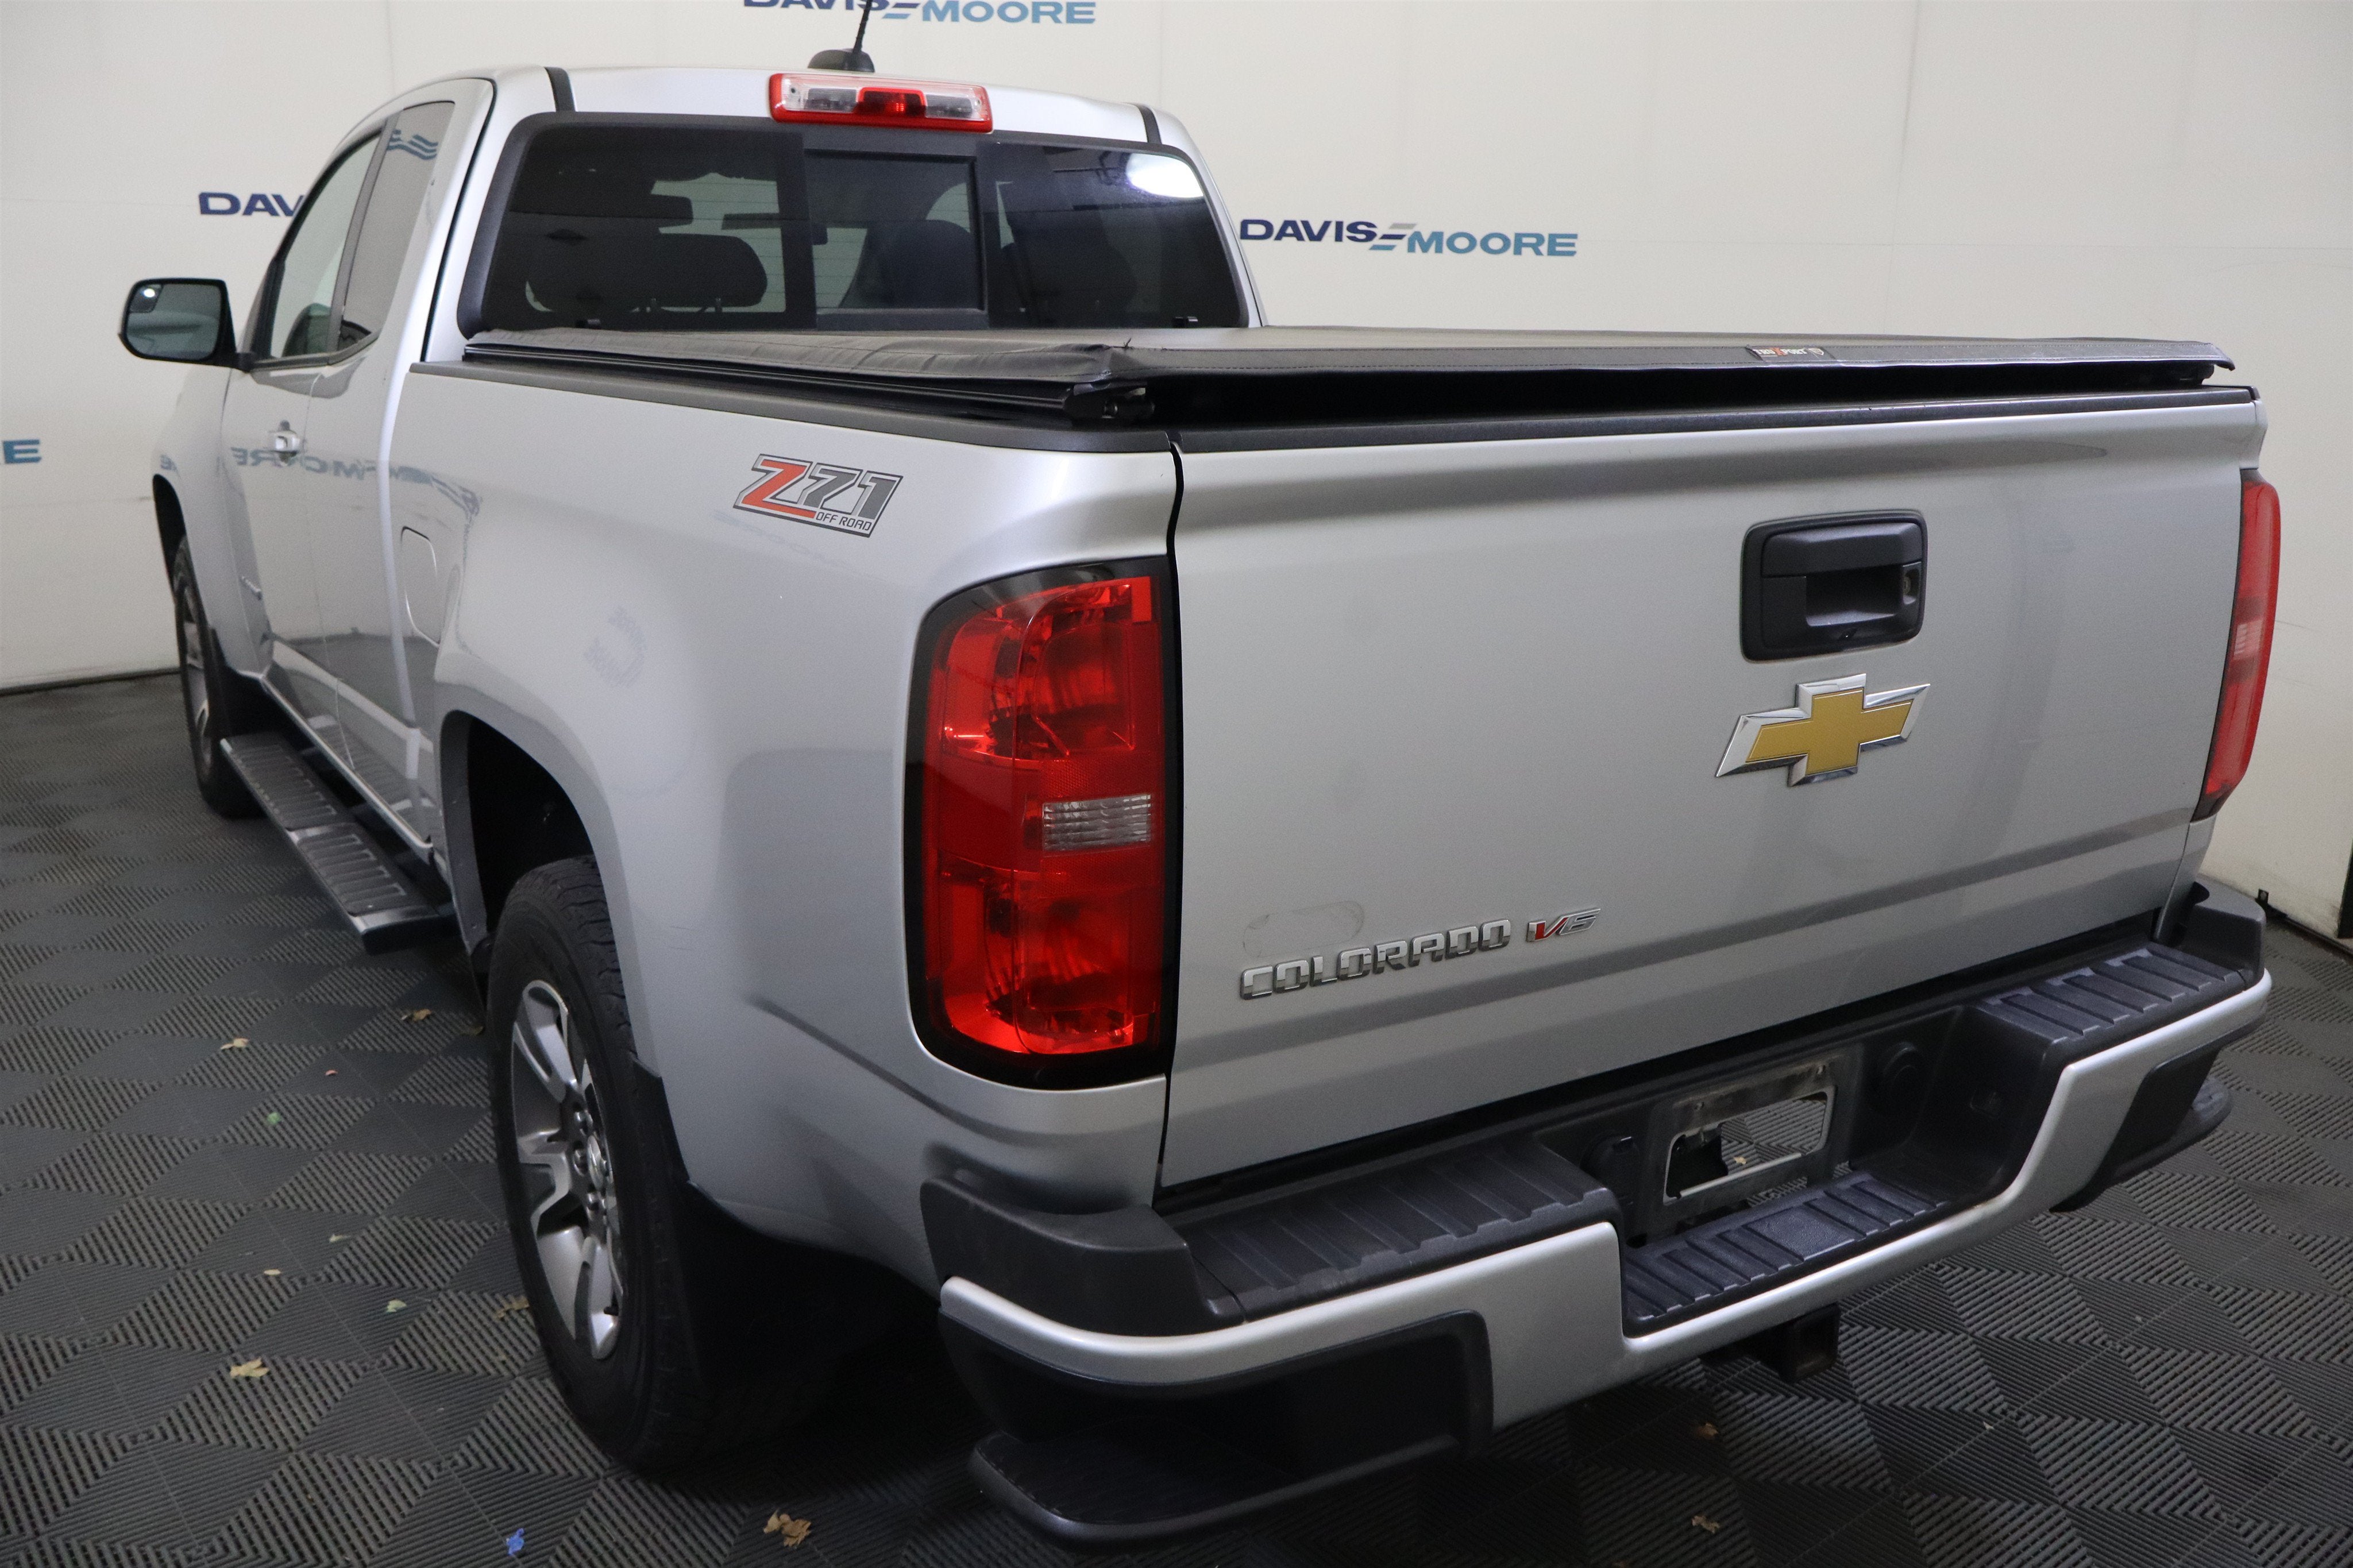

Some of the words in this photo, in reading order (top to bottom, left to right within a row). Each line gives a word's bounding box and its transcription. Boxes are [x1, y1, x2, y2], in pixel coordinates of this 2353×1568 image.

[922, 0, 1096, 24] MOORE
[1240, 219, 1378, 242] DAVIS
[1407, 231, 1579, 257] MOORE
[735, 454, 903, 522] Z71
[816, 512, 838, 523] OFF
[839, 516, 872, 531] ROAD
[1240, 919, 1511, 1000] COLORADO
[1526, 907, 1601, 942] V6
